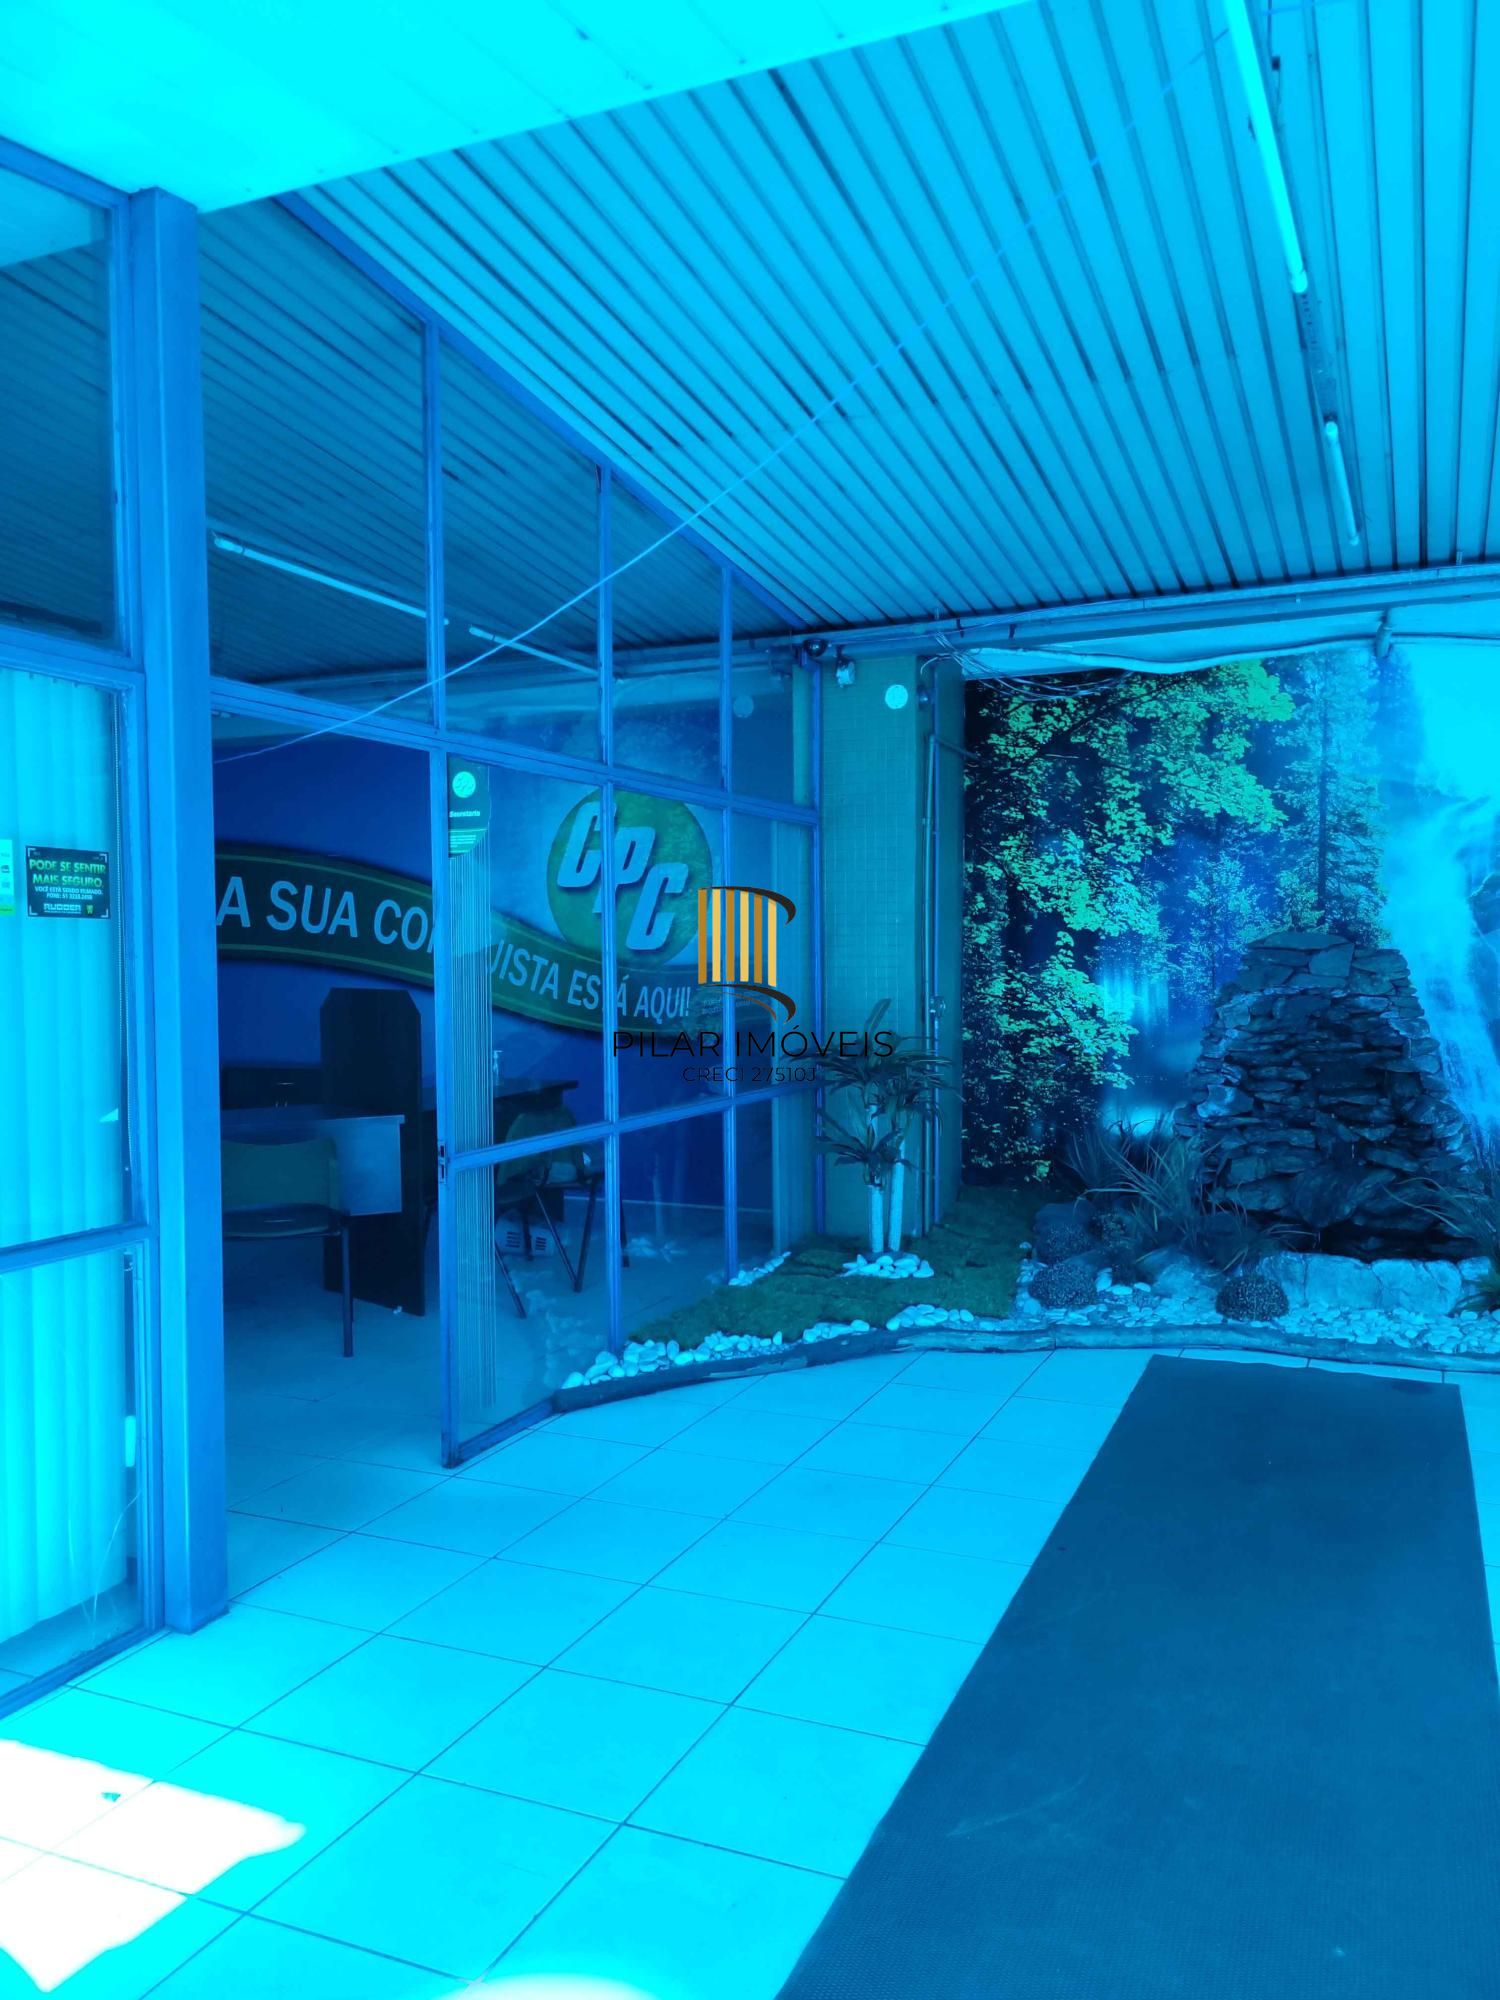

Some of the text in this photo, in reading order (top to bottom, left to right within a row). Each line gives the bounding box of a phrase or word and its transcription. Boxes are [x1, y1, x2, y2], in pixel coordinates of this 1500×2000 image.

[29, 859, 106, 875] PODE SE SENTIR
[32, 873, 59, 885] MAIS
[216, 876, 251, 927] A
[266, 880, 359, 938] SUA
[567, 970, 627, 1017] ESÁ
[633, 986, 691, 1025] AQUI!
